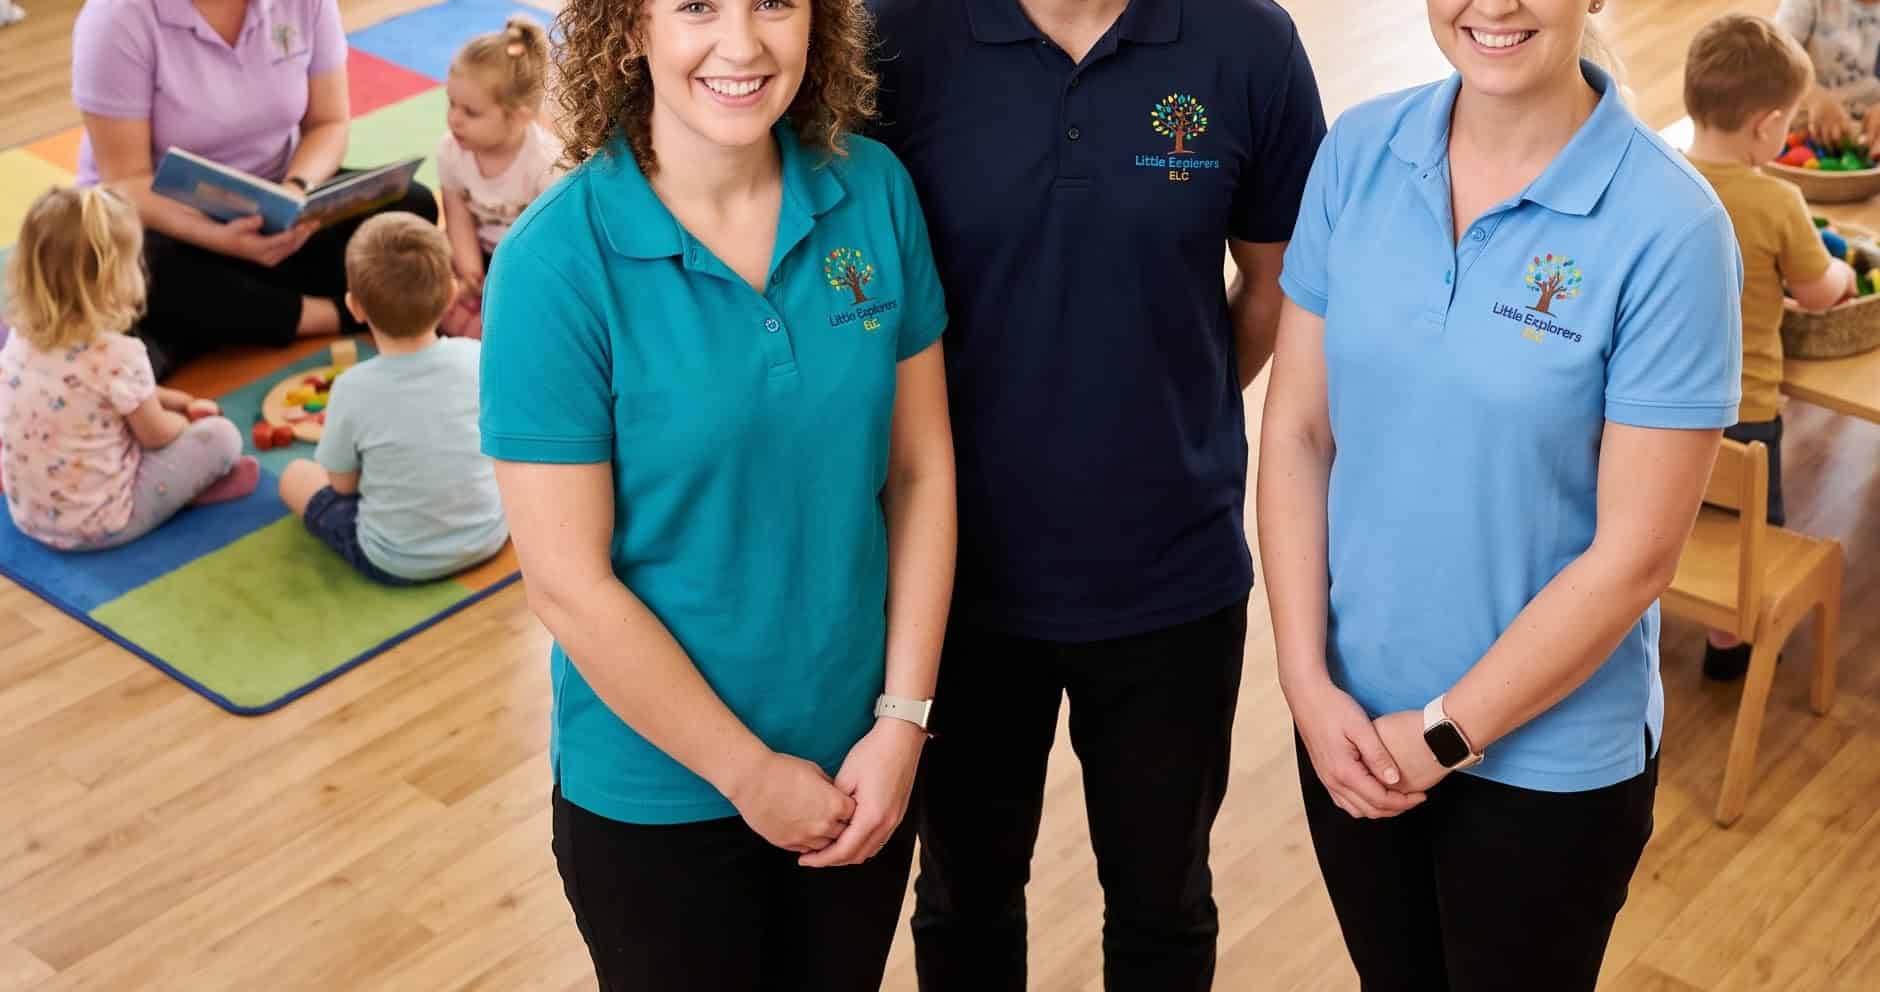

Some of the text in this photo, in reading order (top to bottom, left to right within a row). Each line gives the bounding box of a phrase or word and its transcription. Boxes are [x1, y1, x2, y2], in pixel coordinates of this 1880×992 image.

[1135, 154, 1166, 167] Little
[1168, 171, 1190, 181] ELC
[1492, 301, 1582, 343] Little Explorers
